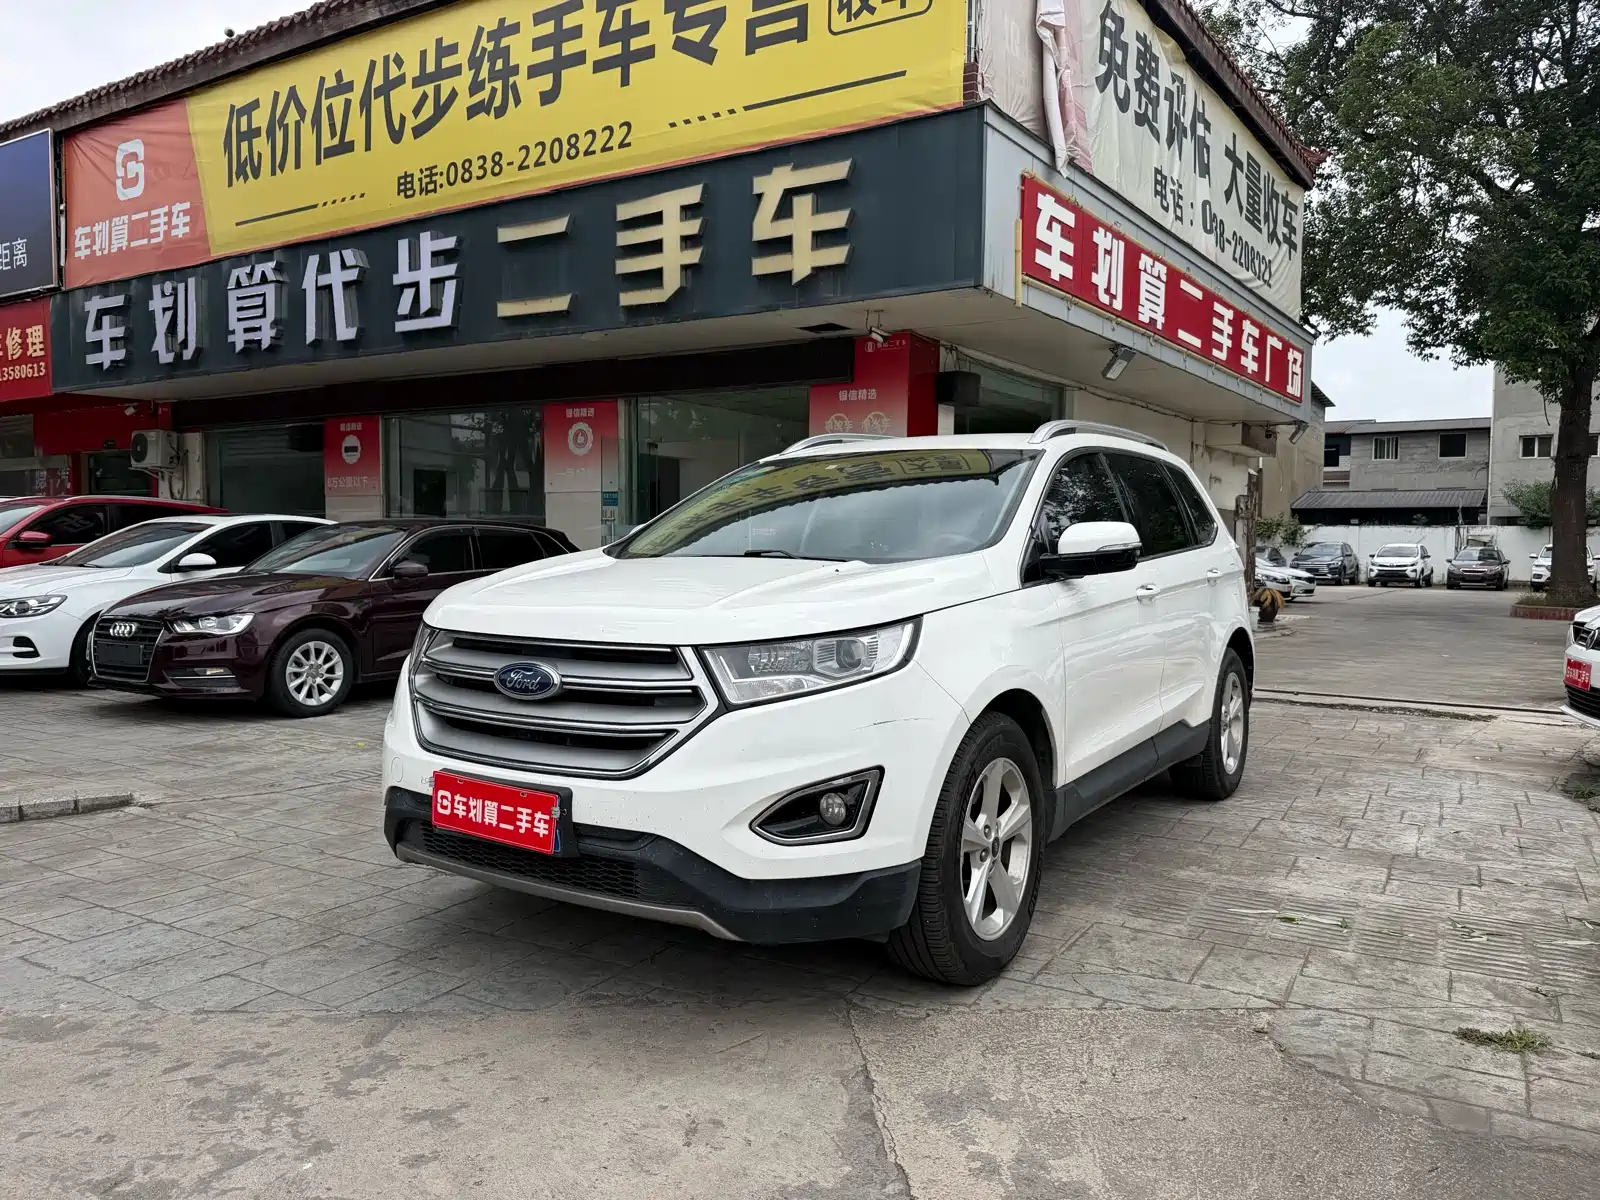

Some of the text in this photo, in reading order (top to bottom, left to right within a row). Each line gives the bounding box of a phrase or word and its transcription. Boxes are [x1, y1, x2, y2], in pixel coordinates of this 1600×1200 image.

[396, 121, 634, 200] 电话:0838-2208222
[1094, 8, 1298, 261] 免费评估 大量收车
[74, 202, 191, 260] 车划算二手车
[84, 157, 854, 371] 车划算代步二手车
[1034, 192, 1303, 399] 车划算二手车广场
[0, 324, 45, 361] 修理
[506, 668, 542, 691] Ford
[452, 792, 550, 838] 车划算二手车
